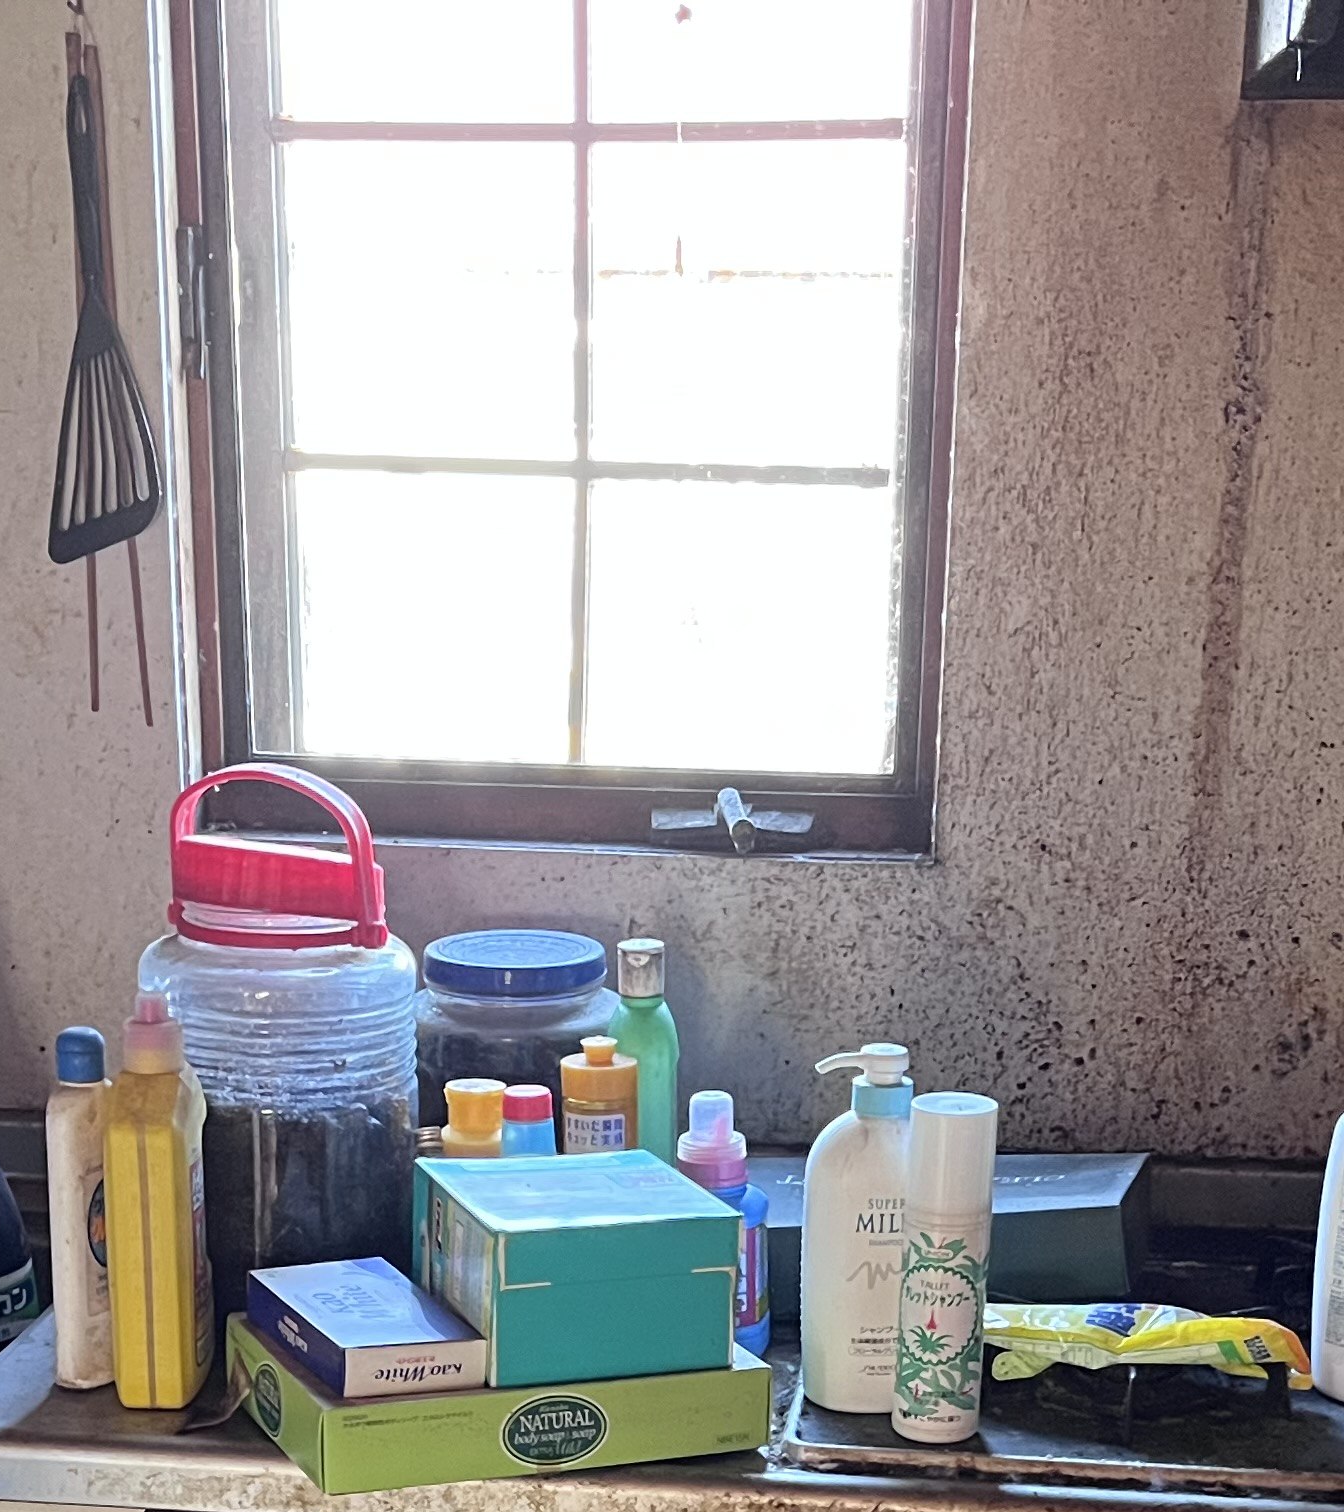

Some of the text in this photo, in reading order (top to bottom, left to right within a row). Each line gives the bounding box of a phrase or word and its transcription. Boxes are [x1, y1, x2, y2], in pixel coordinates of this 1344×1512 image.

[855, 1212, 904, 1234] MIL
[374, 1365, 430, 1384] White
[519, 1408, 595, 1433] NATURAL
